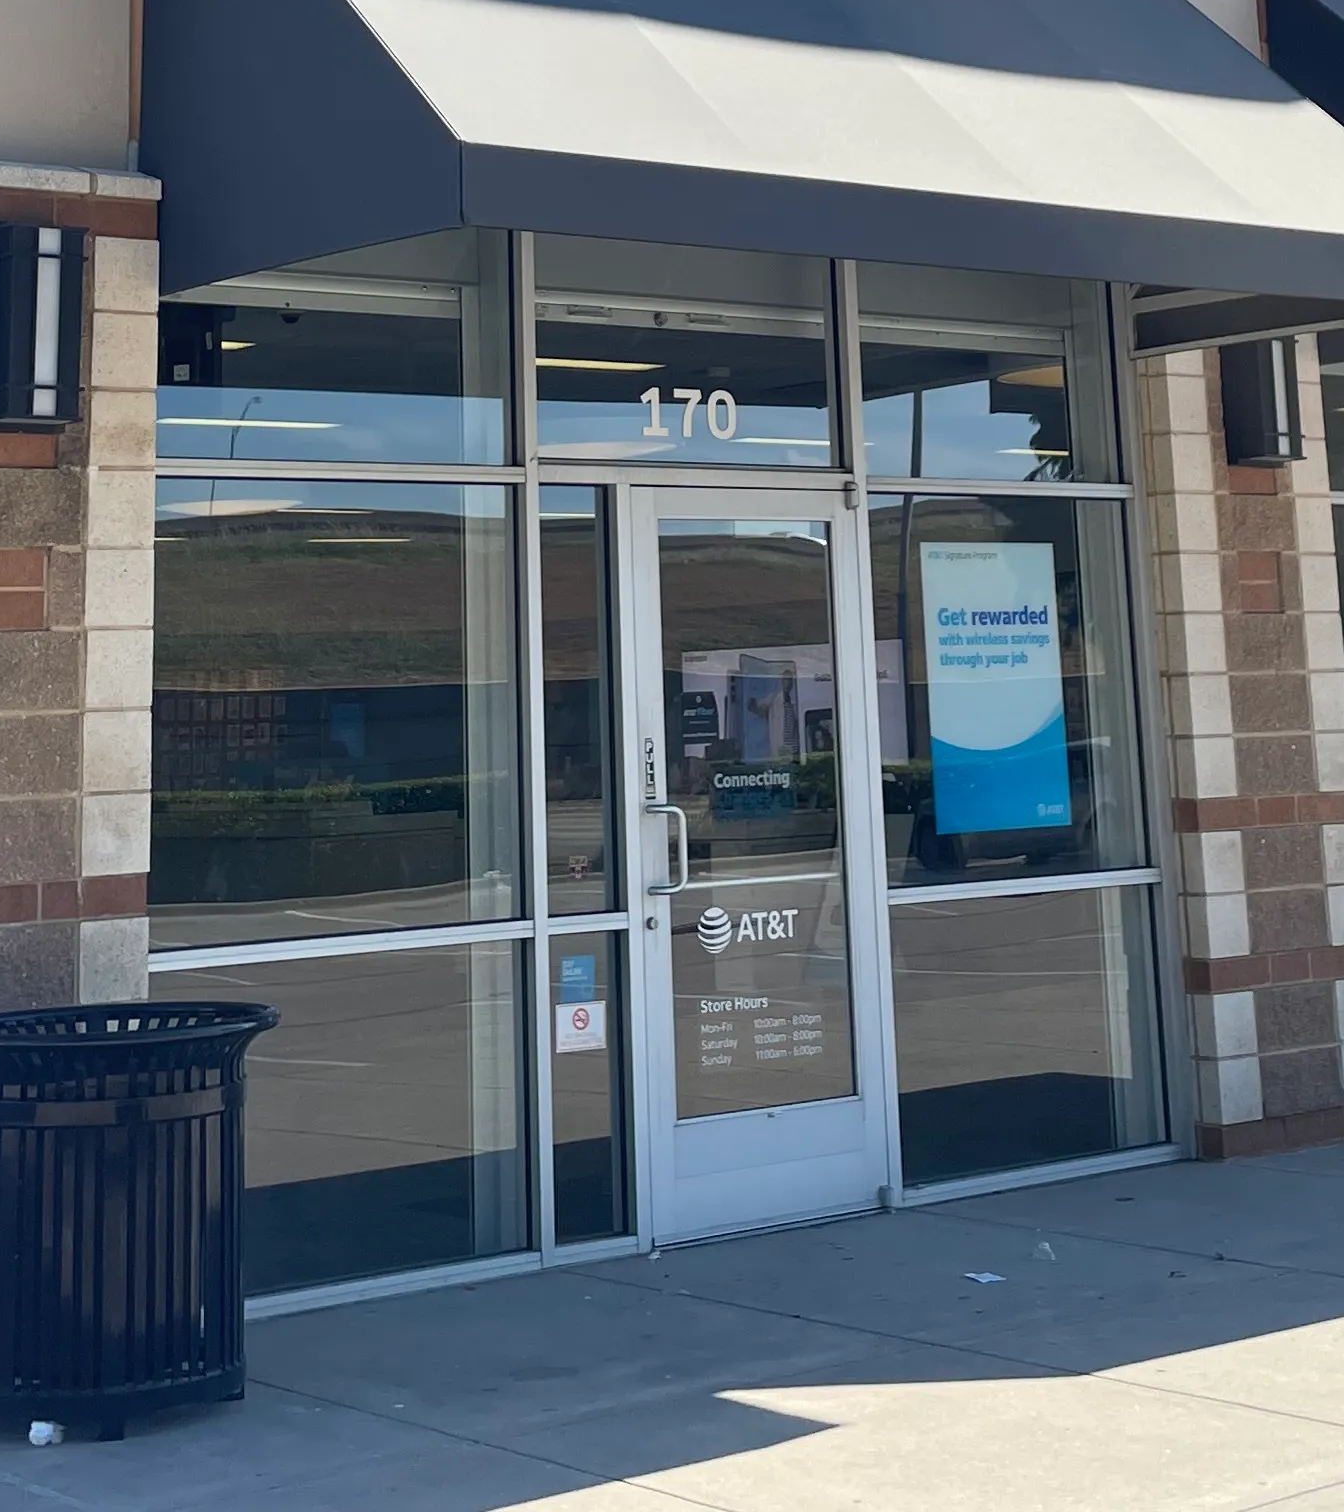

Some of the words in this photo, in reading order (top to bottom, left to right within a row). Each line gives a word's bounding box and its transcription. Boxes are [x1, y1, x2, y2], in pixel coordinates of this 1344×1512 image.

[640, 386, 737, 440] 170
[937, 607, 968, 626] Get
[971, 605, 1049, 626] rewarded
[938, 632, 964, 646] with
[966, 632, 1009, 646] wireless
[1011, 631, 1050, 647] savings
[940, 652, 983, 668] through
[984, 653, 1010, 668] your
[1010, 651, 1028, 667] job
[645, 740, 655, 785] PULL
[713, 769, 791, 789] Connecting
[737, 909, 798, 942] AT&T
[700, 999, 733, 1014] Store
[734, 996, 769, 1010] Hours
[701, 1022, 733, 1034] Mon-Fri
[701, 1037, 738, 1050] Saturday
[701, 1053, 733, 1067] Sunday
